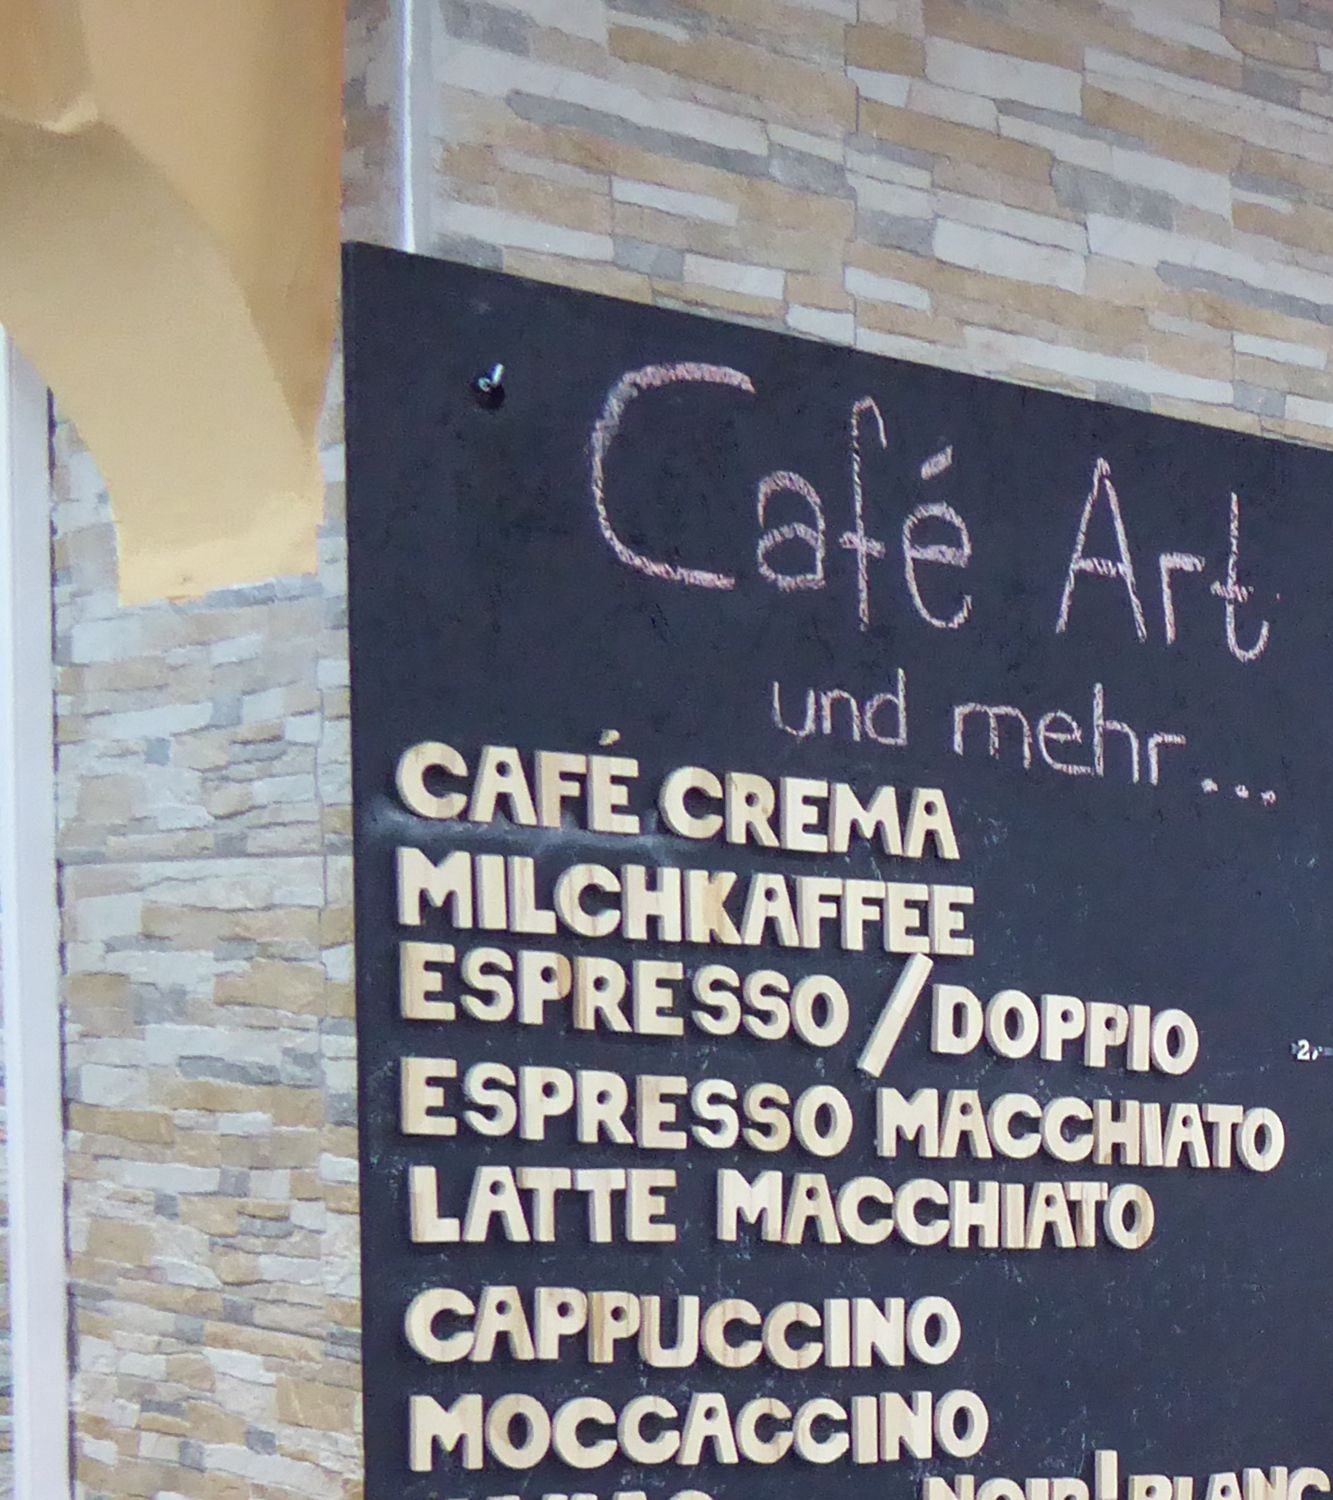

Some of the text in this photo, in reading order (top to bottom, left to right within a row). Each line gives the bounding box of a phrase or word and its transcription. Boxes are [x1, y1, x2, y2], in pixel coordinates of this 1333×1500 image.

[590, 362, 1270, 662] Café Art
[772, 668, 907, 745] und
[396, 732, 960, 859] CAFÉ CREMA
[395, 846, 975, 956] MILCHKAFFEE
[400, 1056, 1285, 1172] ESPRESSO MACCHIATO
[409, 1164, 1154, 1249] LATTE MACCHIATO
[405, 1286, 961, 1369] CAPPUCCINO
[410, 1389, 989, 1472] MOCCACCINO
